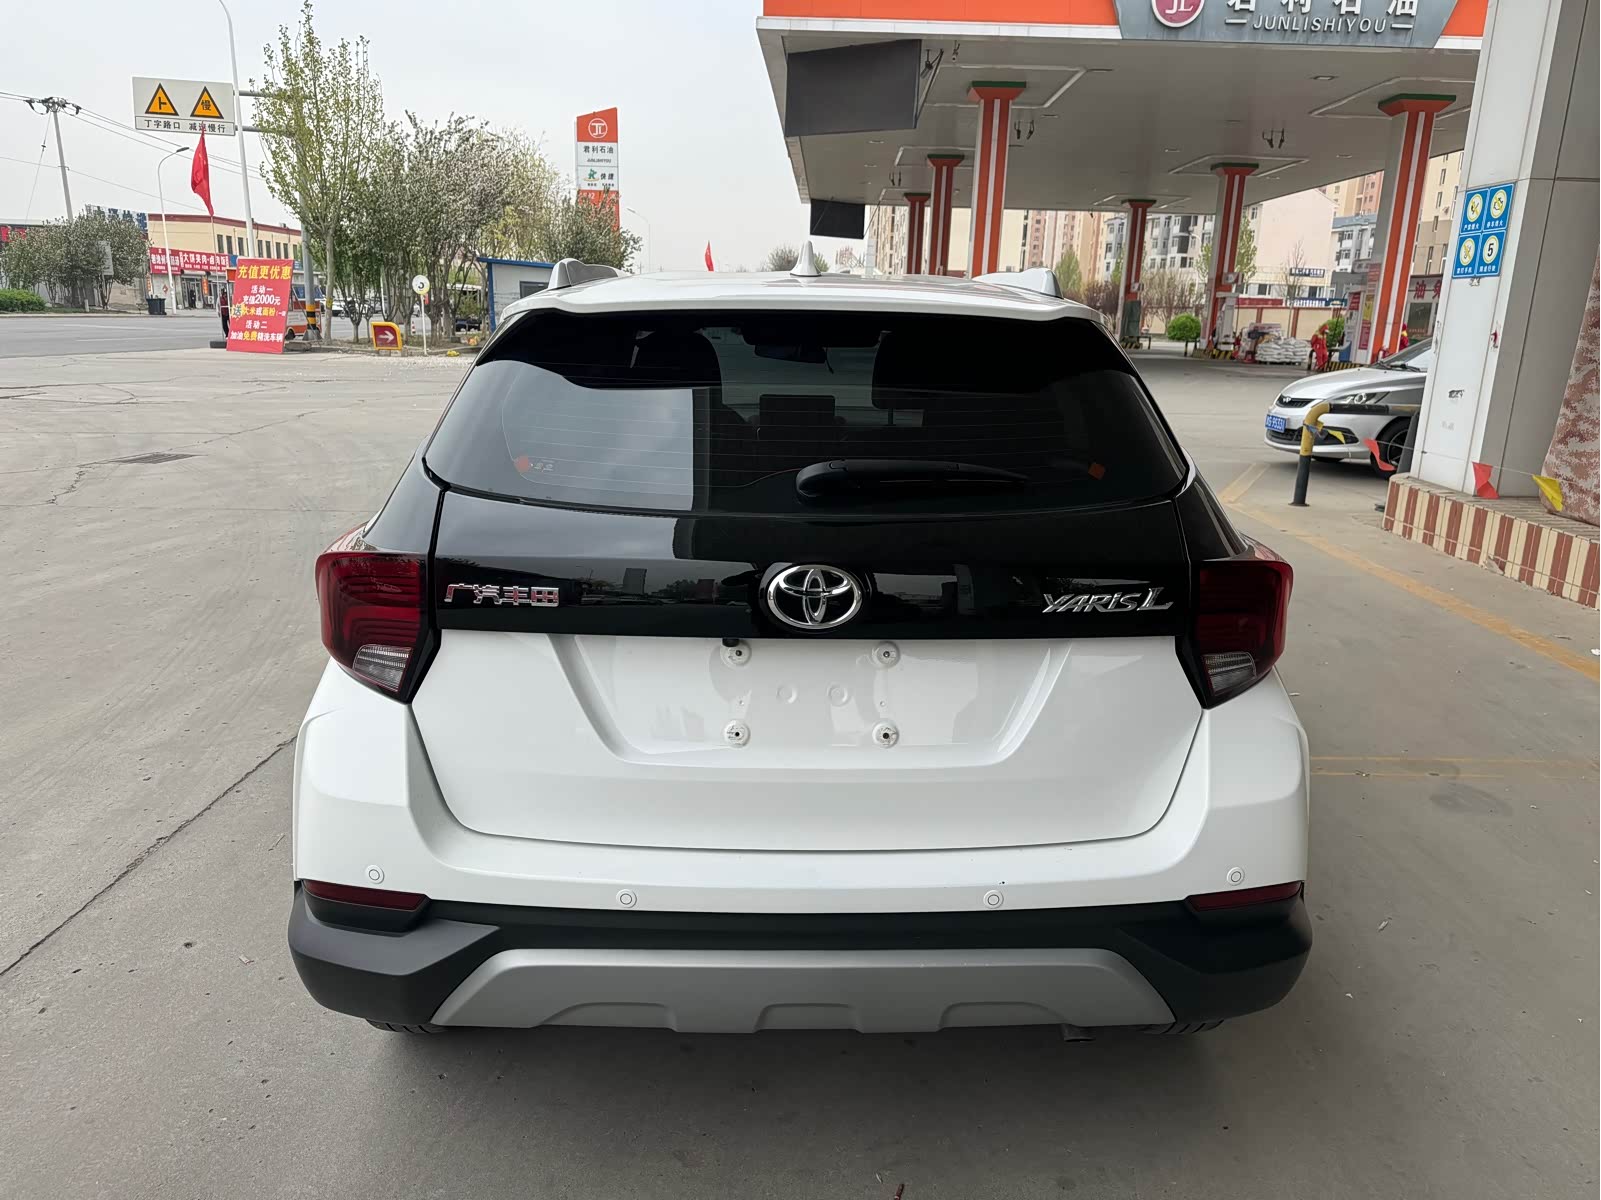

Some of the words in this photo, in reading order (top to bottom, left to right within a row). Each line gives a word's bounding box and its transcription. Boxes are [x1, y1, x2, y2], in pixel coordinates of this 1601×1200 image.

[1253, 15, 1387, 34] JUNLISHIYOU
[144, 119, 181, 130] 丁字路口
[189, 122, 225, 133] 减速慢行
[583, 145, 614, 154] 君利石油
[1487, 242, 1495, 258] 5
[237, 264, 292, 280] 充值更优惠
[250, 284, 274, 294] 活动一
[242, 294, 282, 306] 充值2000元
[245, 320, 268, 330] 活动二
[444, 583, 560, 607] 广汽丰田
[1137, 586, 1174, 611] L
